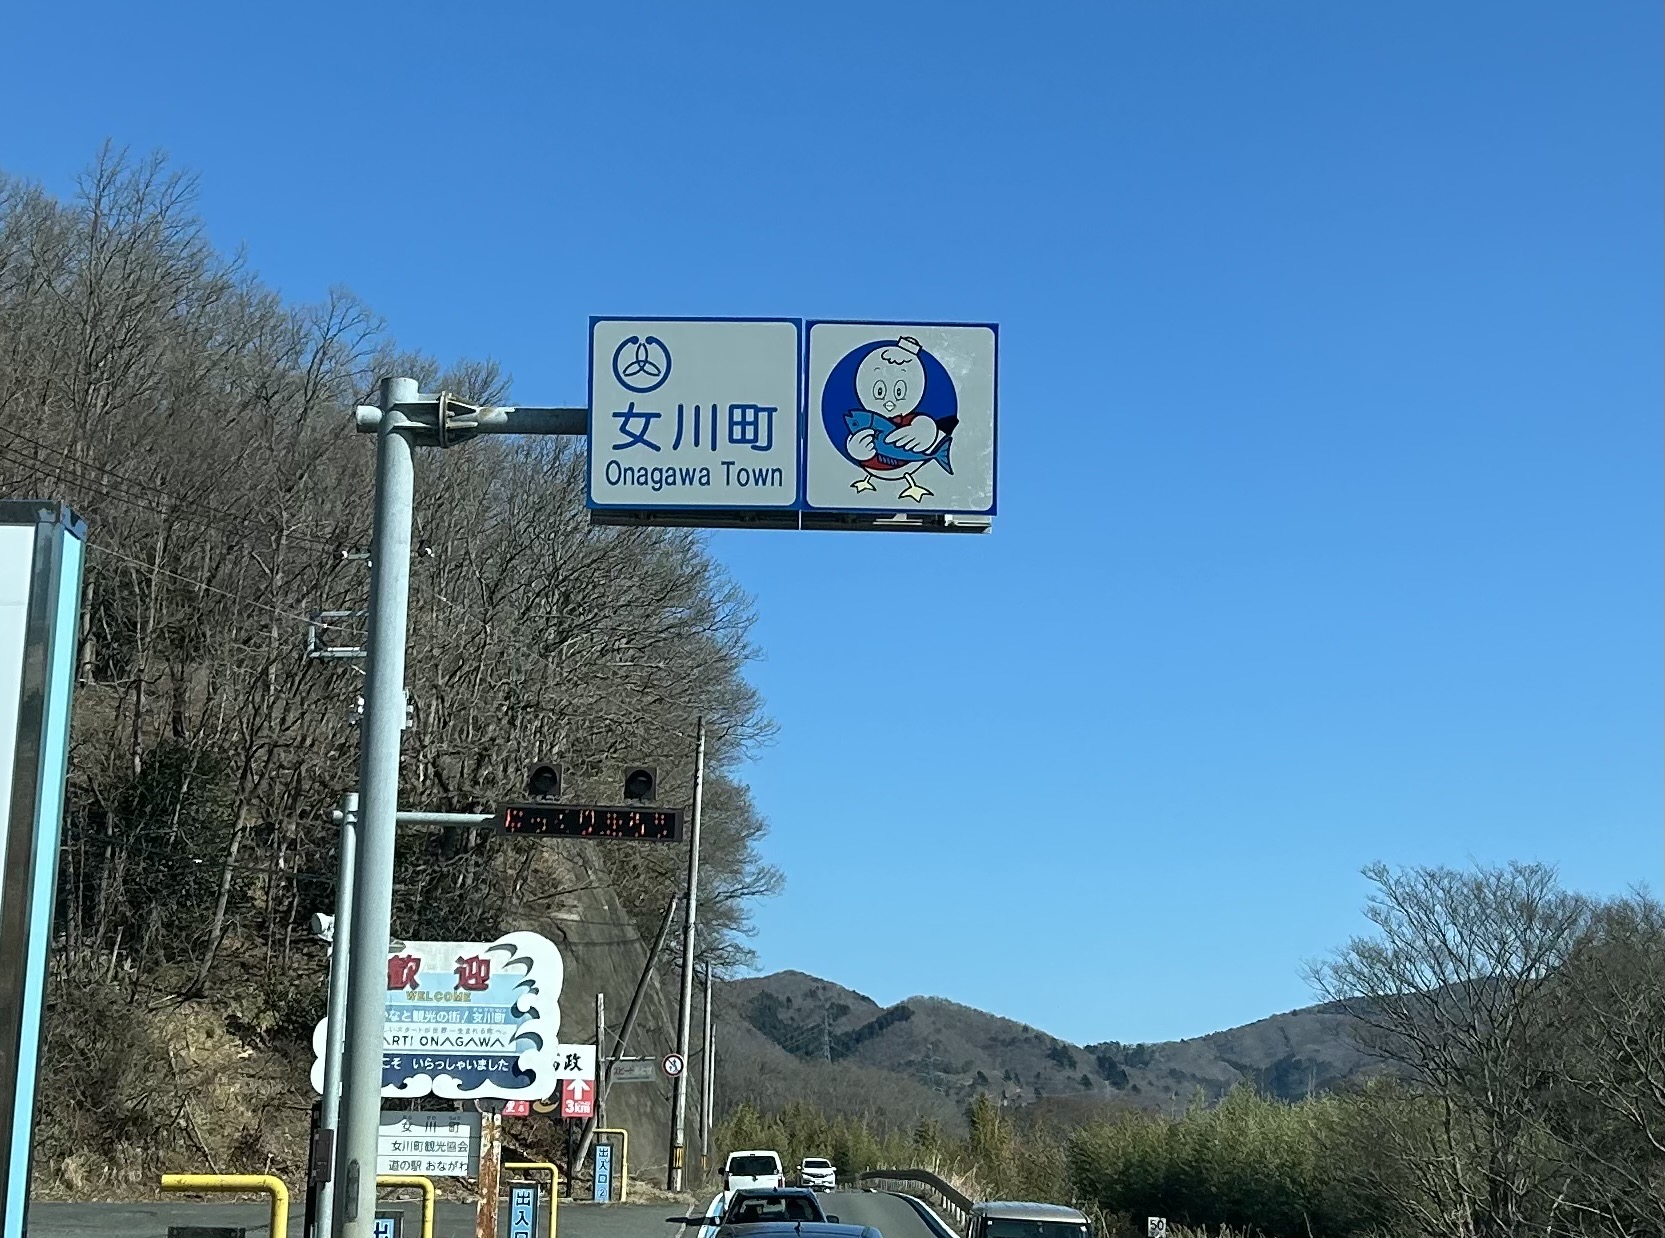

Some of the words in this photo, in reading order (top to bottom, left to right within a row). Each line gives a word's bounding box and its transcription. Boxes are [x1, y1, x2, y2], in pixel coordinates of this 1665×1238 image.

[612, 402, 778, 452] 女川町
[605, 460, 711, 491] Onagawa
[721, 461, 783, 487] Town
[406, 990, 472, 1003] WELCOME
[419, 1036, 505, 1048] ONAGAWA
[412, 1058, 509, 1072] いらっしゃいました
[401, 1120, 461, 1133] 女川町
[391, 1140, 468, 1153] 女川町観光協会
[389, 1159, 422, 1171] 道の駅
[425, 1160, 468, 1172] おながわ
[1151, 1220, 1164, 1231] 50
